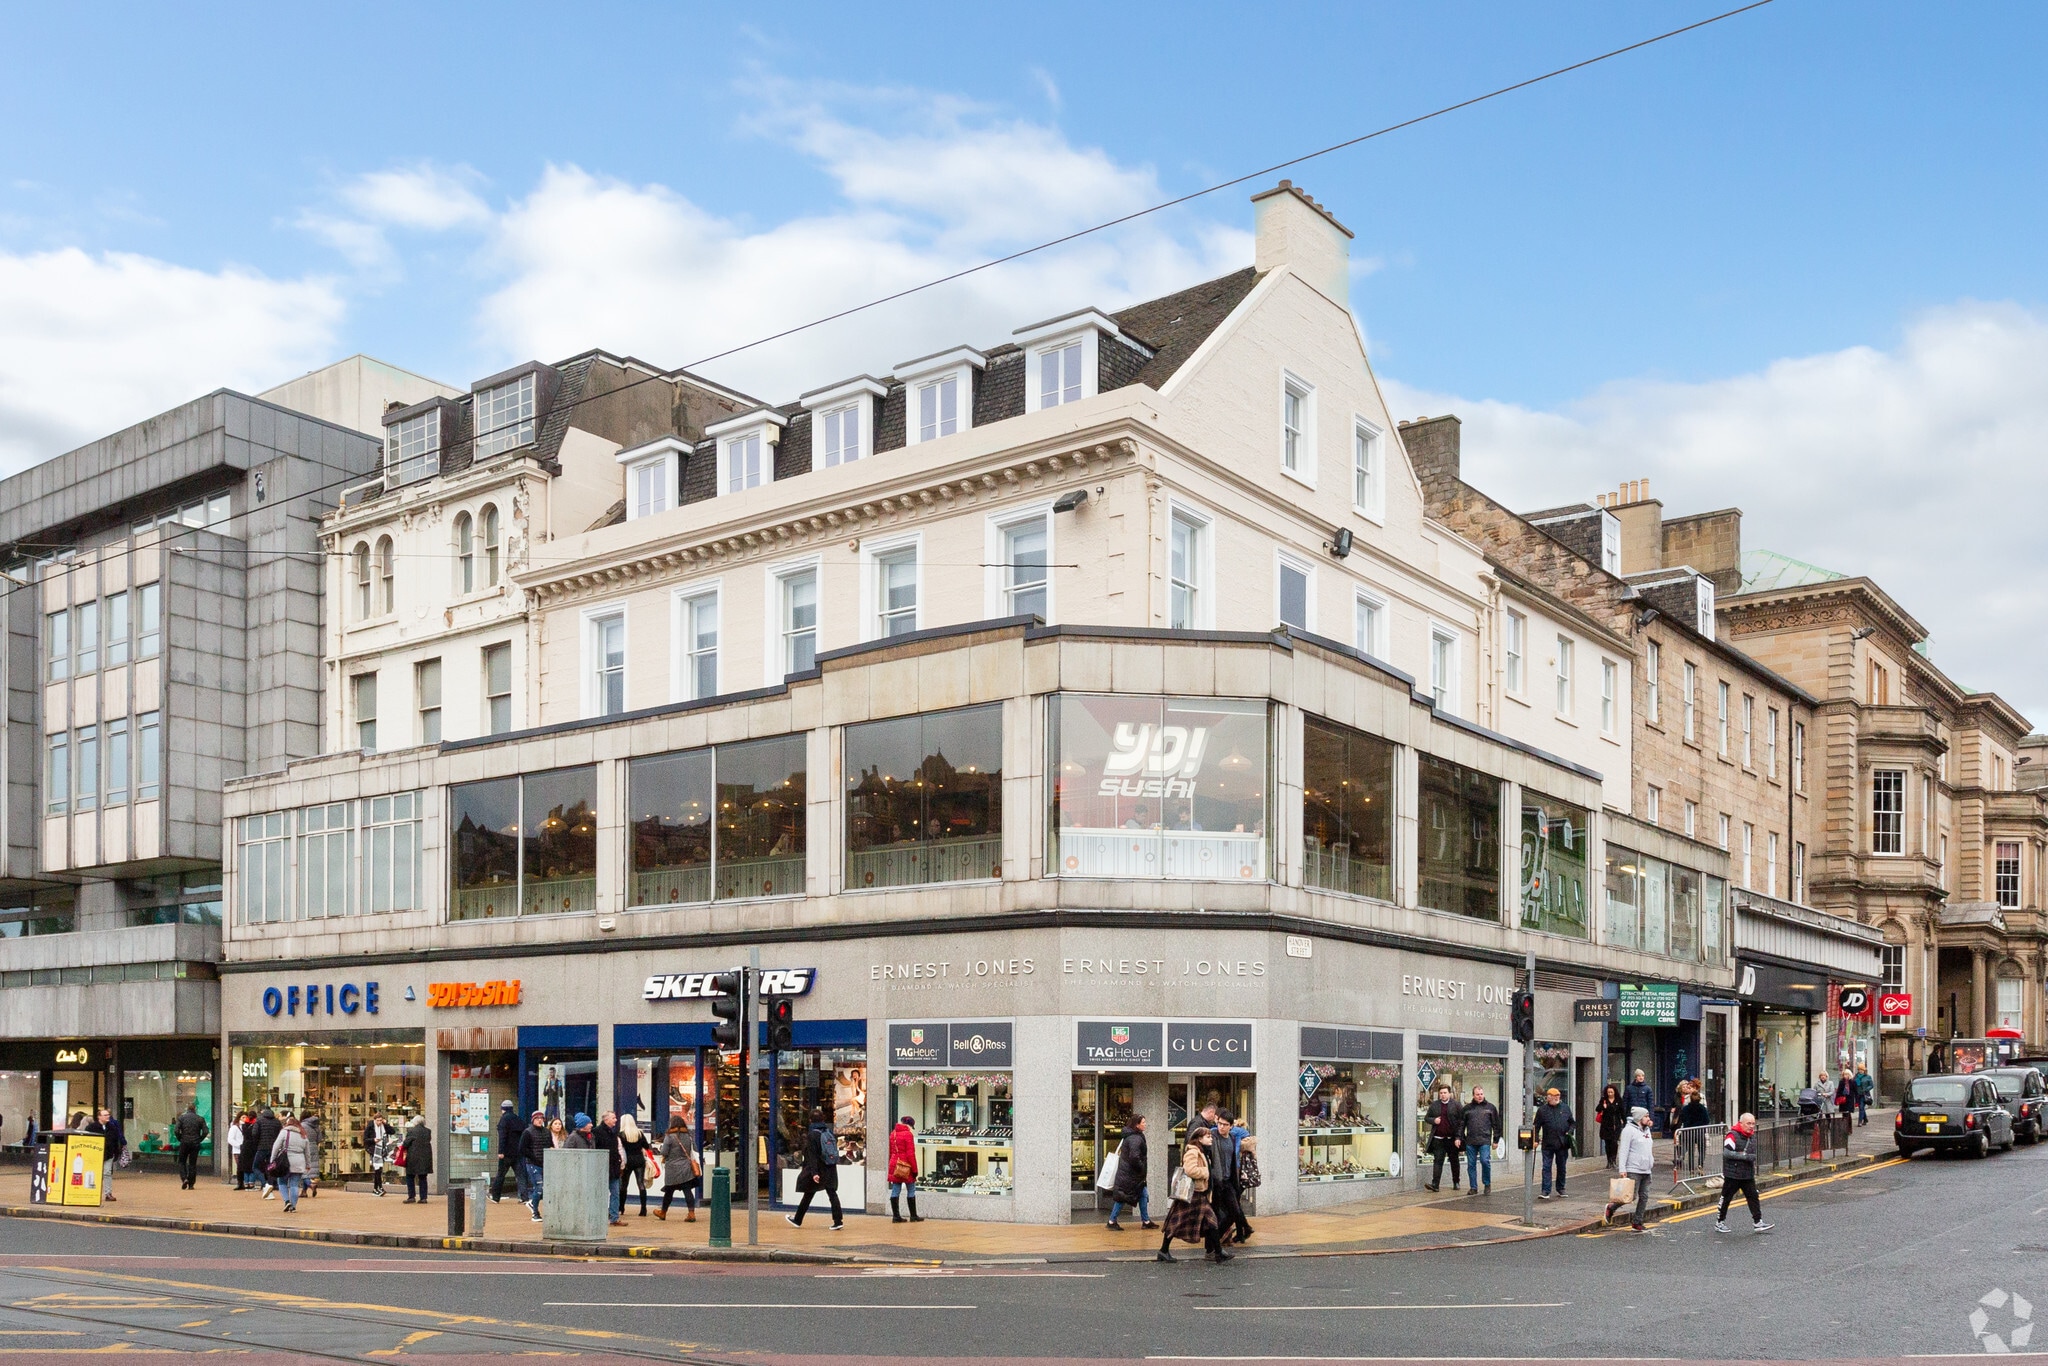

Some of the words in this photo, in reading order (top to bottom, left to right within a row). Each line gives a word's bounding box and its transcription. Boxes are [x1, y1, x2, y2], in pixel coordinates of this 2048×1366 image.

[1290, 947, 1308, 955] STREET
[871, 962, 950, 980] ERNEST
[964, 958, 1035, 977] JONES
[1063, 958, 1164, 974] ERNEST
[1183, 960, 1266, 977] JONES
[1091, 979, 1142, 987] DIAMOND
[1162, 980, 1198, 988] WATCH
[1739, 966, 1756, 995] JD
[1402, 974, 1466, 1001] ERNEST
[1476, 984, 1520, 1006] JONE
[263, 982, 379, 1016] OFFICE
[1621, 1000, 1640, 1008] 0207
[1641, 1001, 1655, 1009] 182
[1656, 1001, 1676, 1009] 8153
[1843, 993, 1864, 1008] JD
[1403, 1003, 1416, 1012] THE
[1464, 1010, 1486, 1019] WATCH
[953, 1039, 970, 1050] Bell
[985, 1039, 1007, 1050] Ross
[1172, 1038, 1248, 1052] GUCCI
